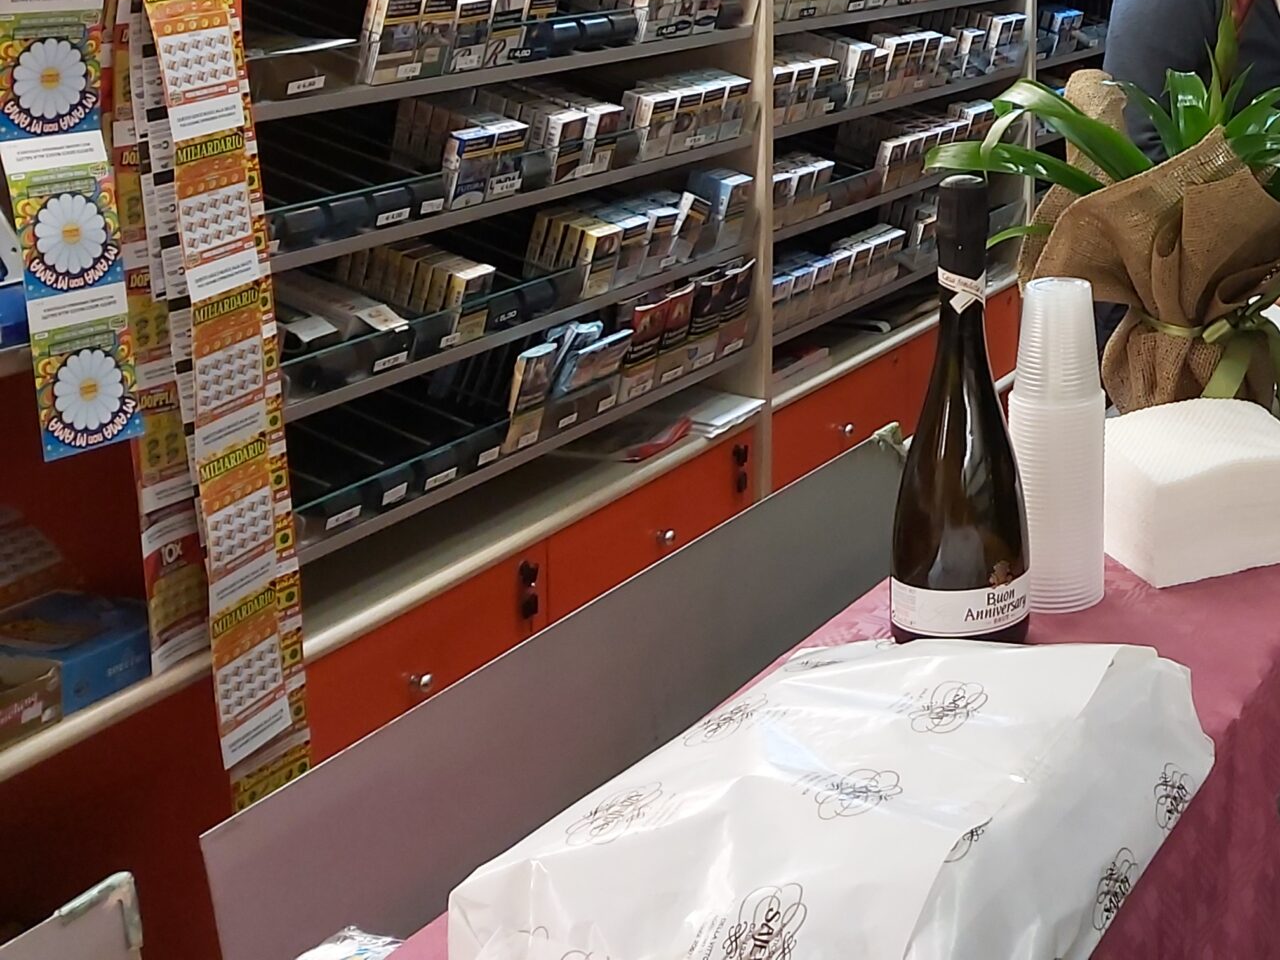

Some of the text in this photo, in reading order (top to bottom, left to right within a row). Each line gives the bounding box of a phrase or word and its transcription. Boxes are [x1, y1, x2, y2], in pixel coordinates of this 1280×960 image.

[60, 93, 98, 130] M'AMA
[176, 135, 243, 164] MILIARDARIO
[82, 244, 119, 285] M'AMA
[194, 287, 260, 325] MILIARDARIO
[104, 398, 136, 440] M'AMA
[200, 439, 265, 481] MILIARDARIO
[213, 587, 275, 638] MILIARDARIO
[987, 588, 1015, 606] Buon
